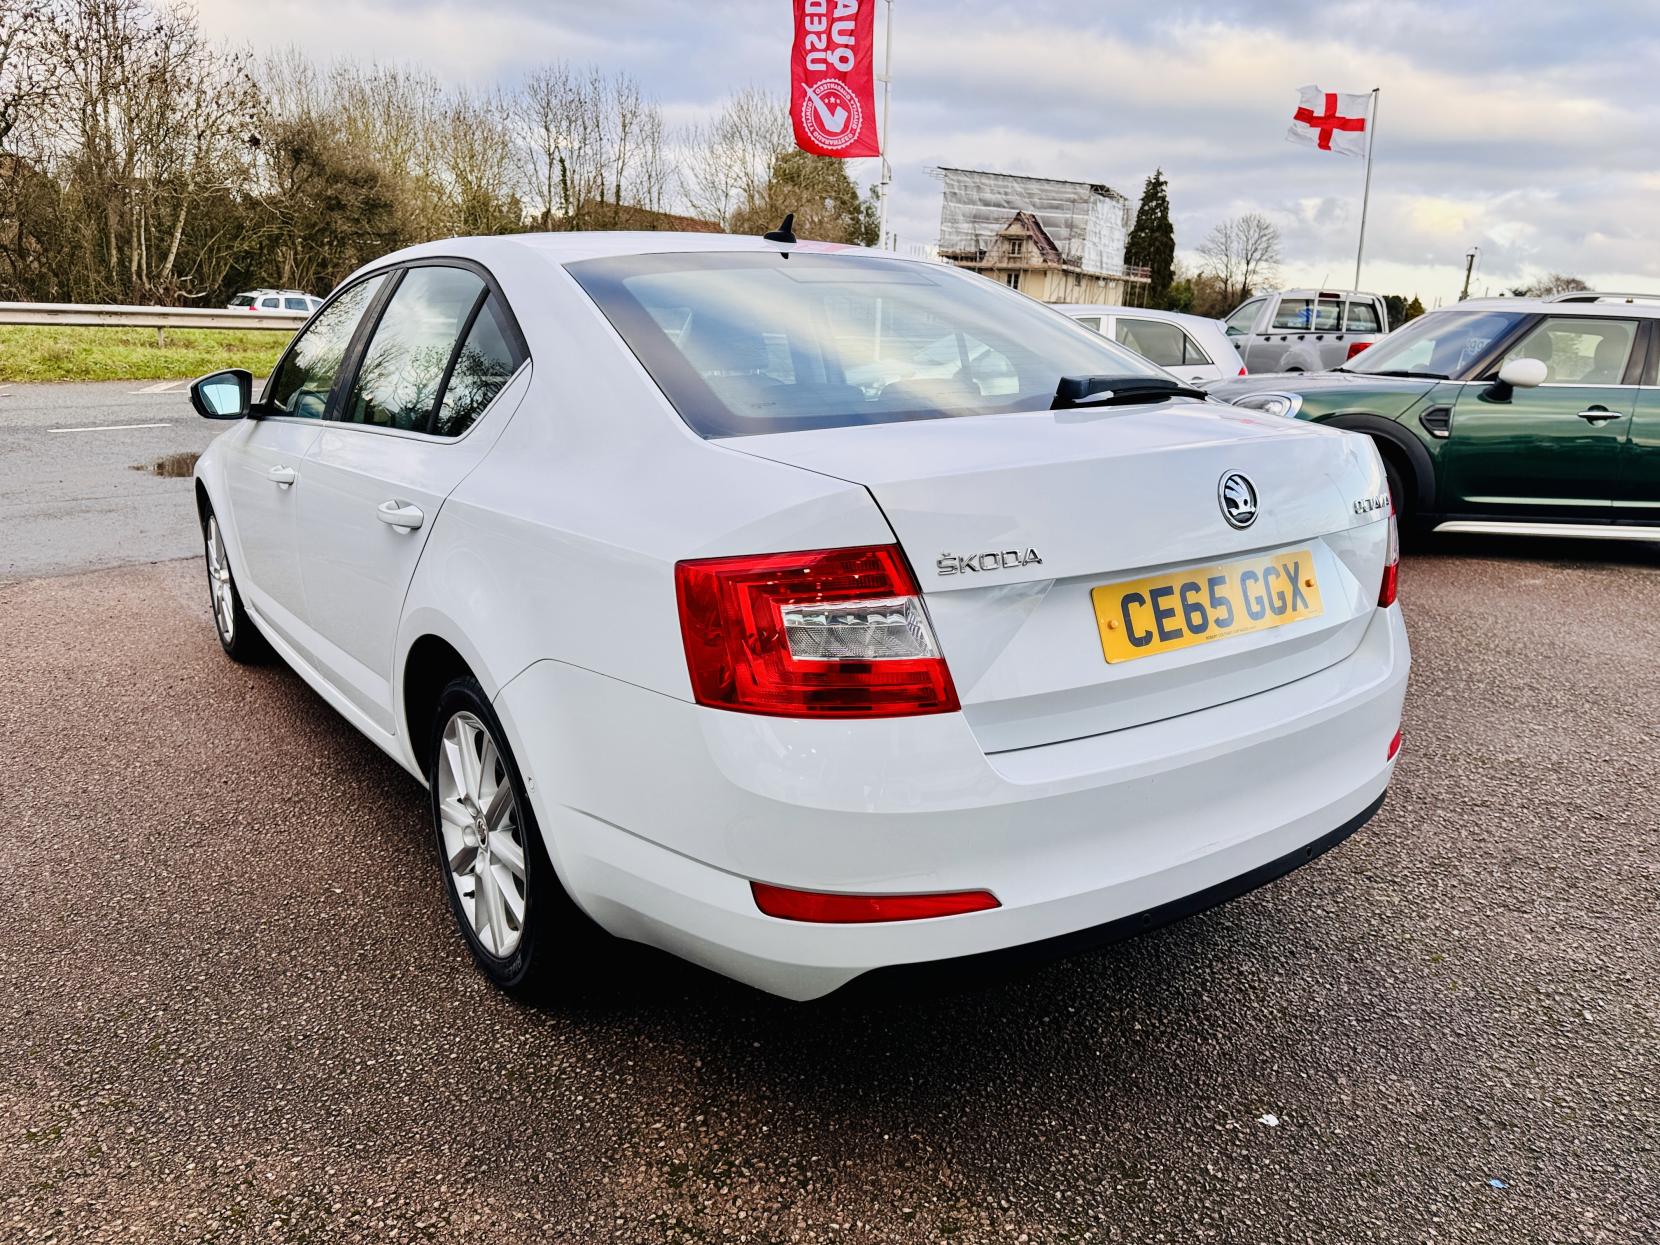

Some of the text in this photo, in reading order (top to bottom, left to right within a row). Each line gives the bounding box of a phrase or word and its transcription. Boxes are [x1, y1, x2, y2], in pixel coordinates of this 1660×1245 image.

[936, 547, 1043, 576] ŠKODA
[1120, 561, 1310, 648] CE65 GGX
